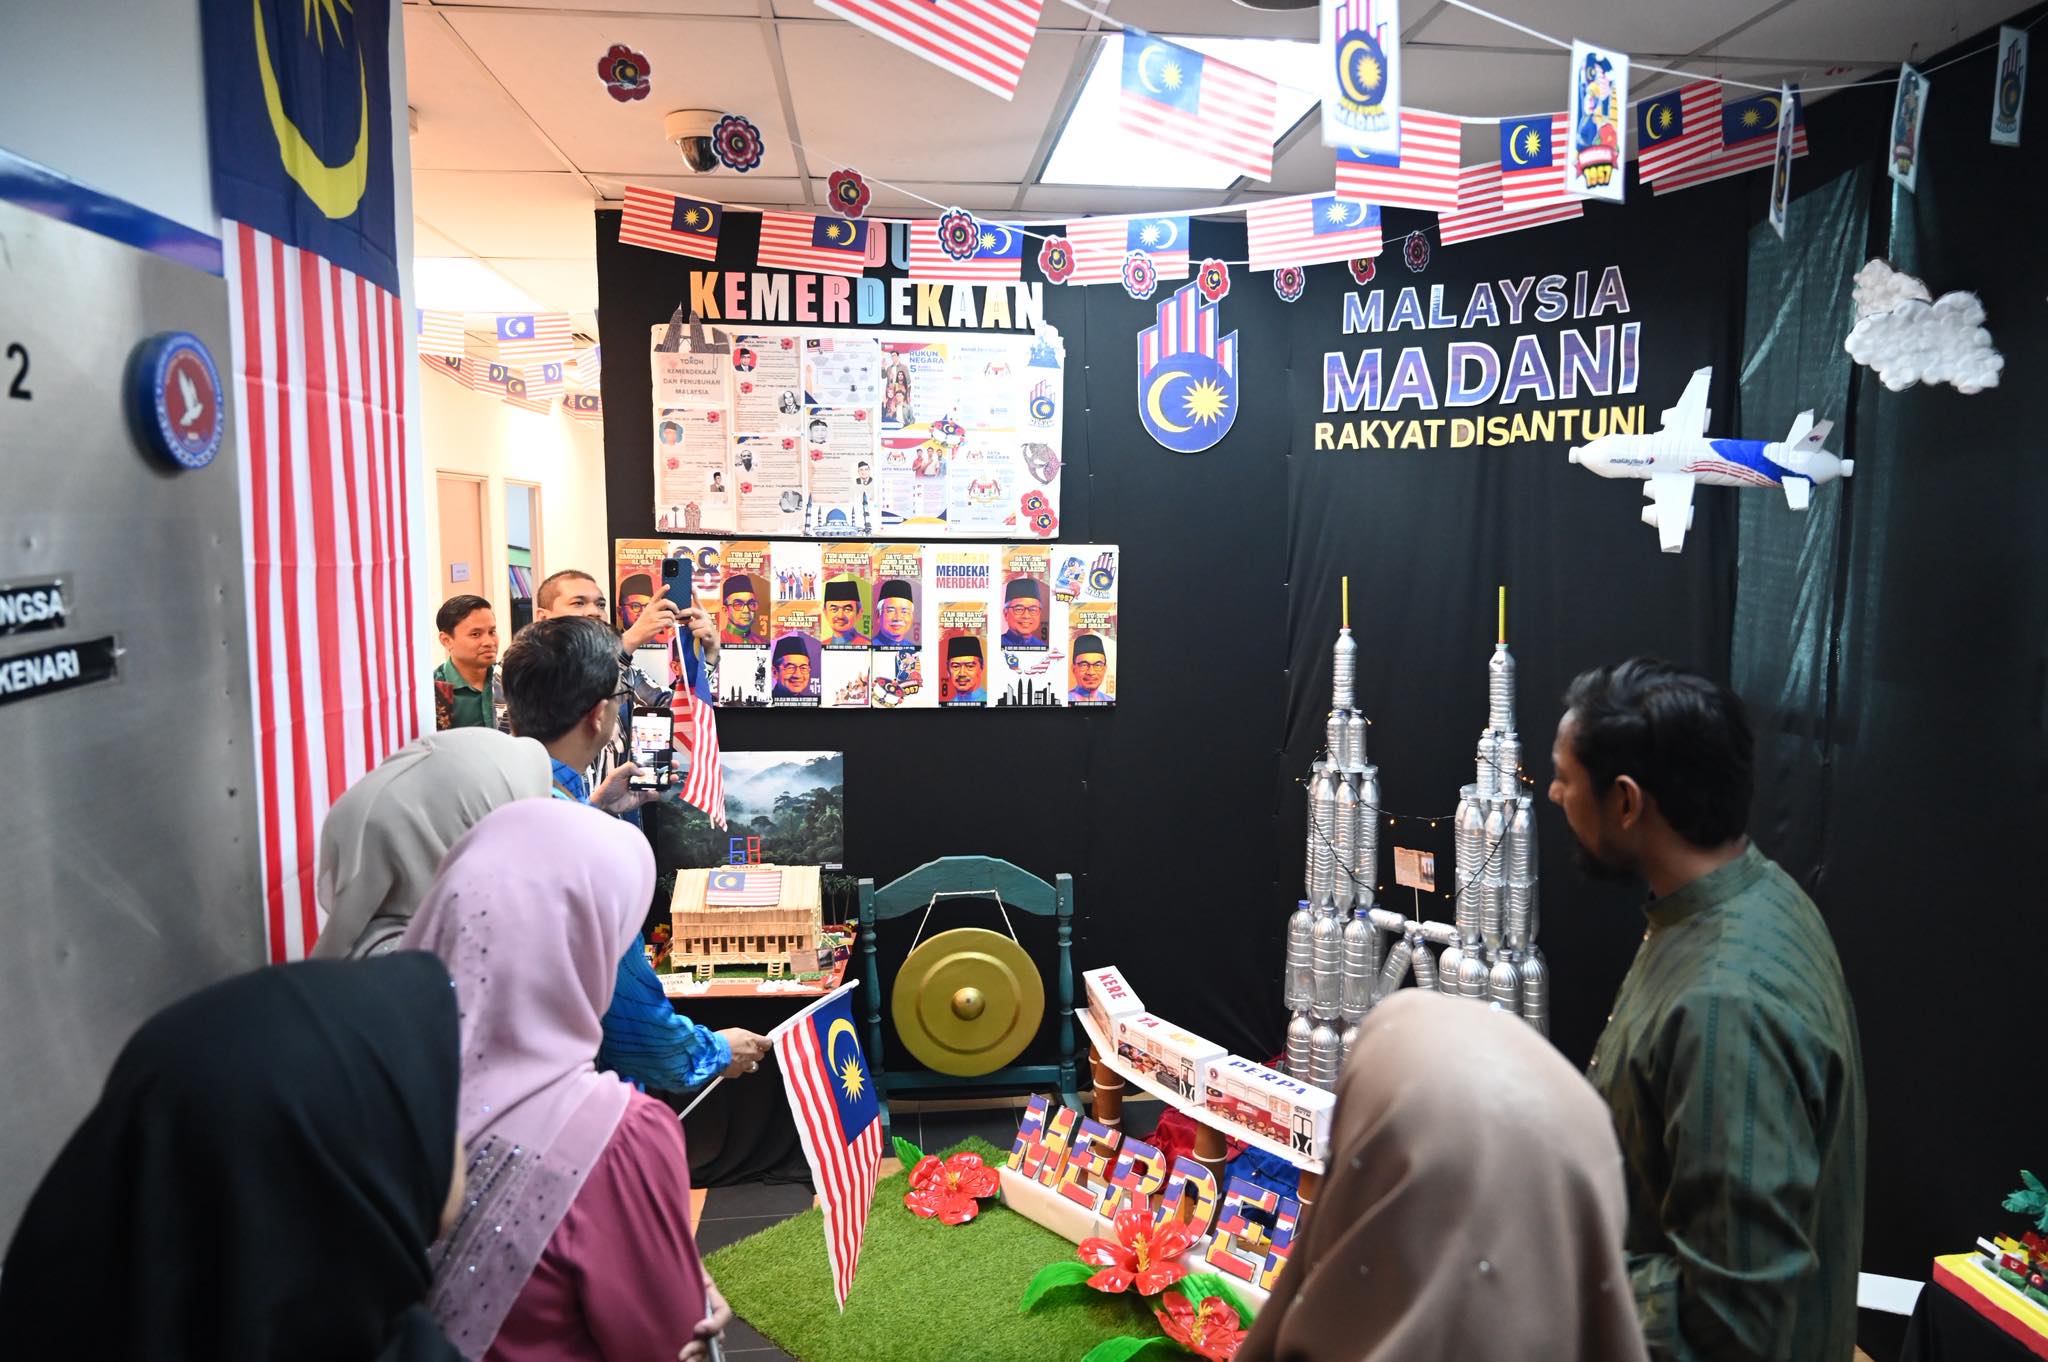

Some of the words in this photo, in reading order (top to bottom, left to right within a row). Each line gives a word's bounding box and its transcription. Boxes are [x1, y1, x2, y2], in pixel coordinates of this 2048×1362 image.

[690, 270, 1044, 333] KEMERDEKAAN
[1342, 265, 1631, 335] MALAYSIA
[6, 342, 33, 400] 2
[1322, 321, 1642, 413] MADANI
[1313, 418, 1446, 451] RAKYAT
[1450, 404, 1646, 448] DISANTUNI
[936, 565, 990, 577] MERDEKA!
[936, 577, 990, 589] MERDEKA!
[1056, 593, 1075, 602] 1957
[760, 621, 768, 636] 3
[863, 620, 870, 635] 5
[1041, 626, 1048, 641] 9
[942, 684, 948, 697] 8
[729, 835, 761, 865] 68
[1098, 973, 1128, 1000] KERE
[1228, 1061, 1307, 1095] PERPA
